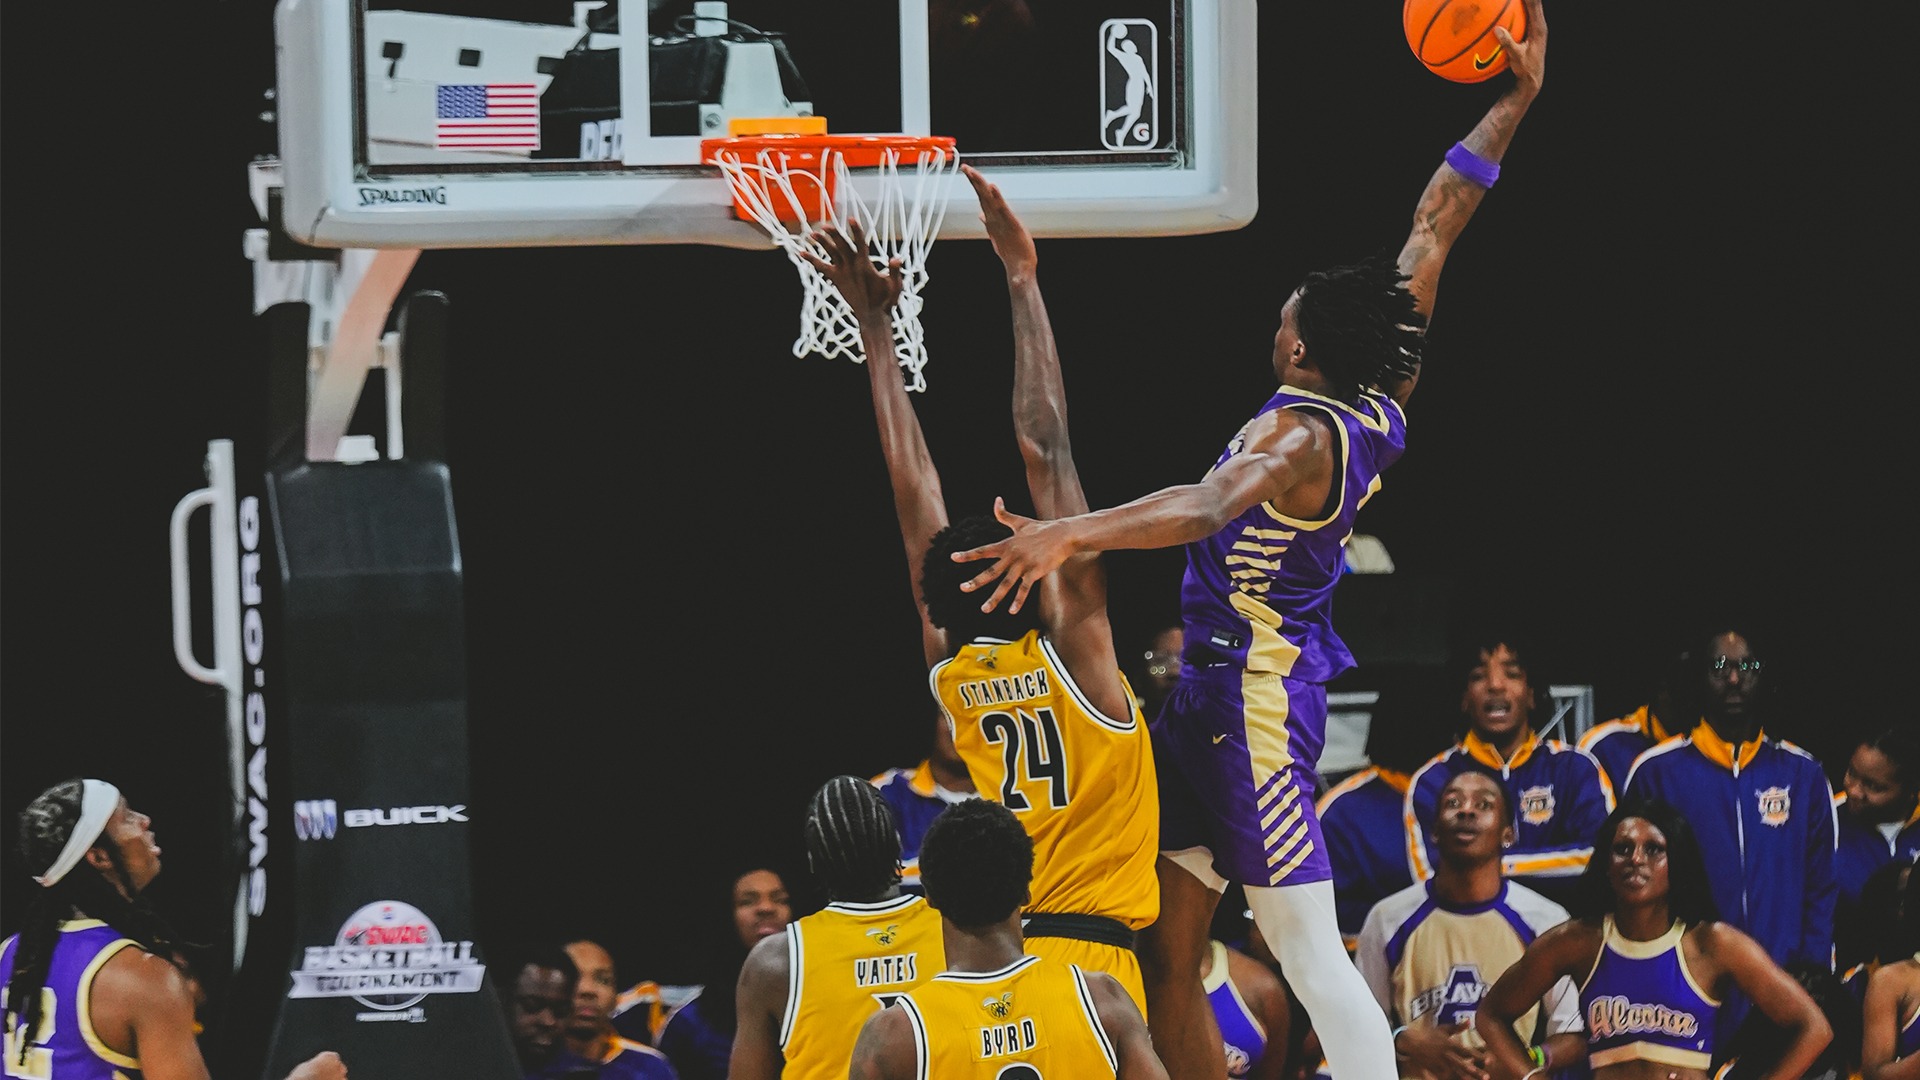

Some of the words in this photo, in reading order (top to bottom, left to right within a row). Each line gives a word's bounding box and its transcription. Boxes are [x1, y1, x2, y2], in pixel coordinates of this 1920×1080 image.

[358, 186, 447, 206] SPALDING
[238, 496, 269, 917] SWAC.ORG
[958, 667, 1051, 709] STANBACK
[979, 706, 1070, 812] 24
[344, 804, 470, 827] BUICK
[854, 952, 918, 988] YATES
[979, 1017, 1038, 1059] BYRD
[1588, 995, 1699, 1043] Alcorn
